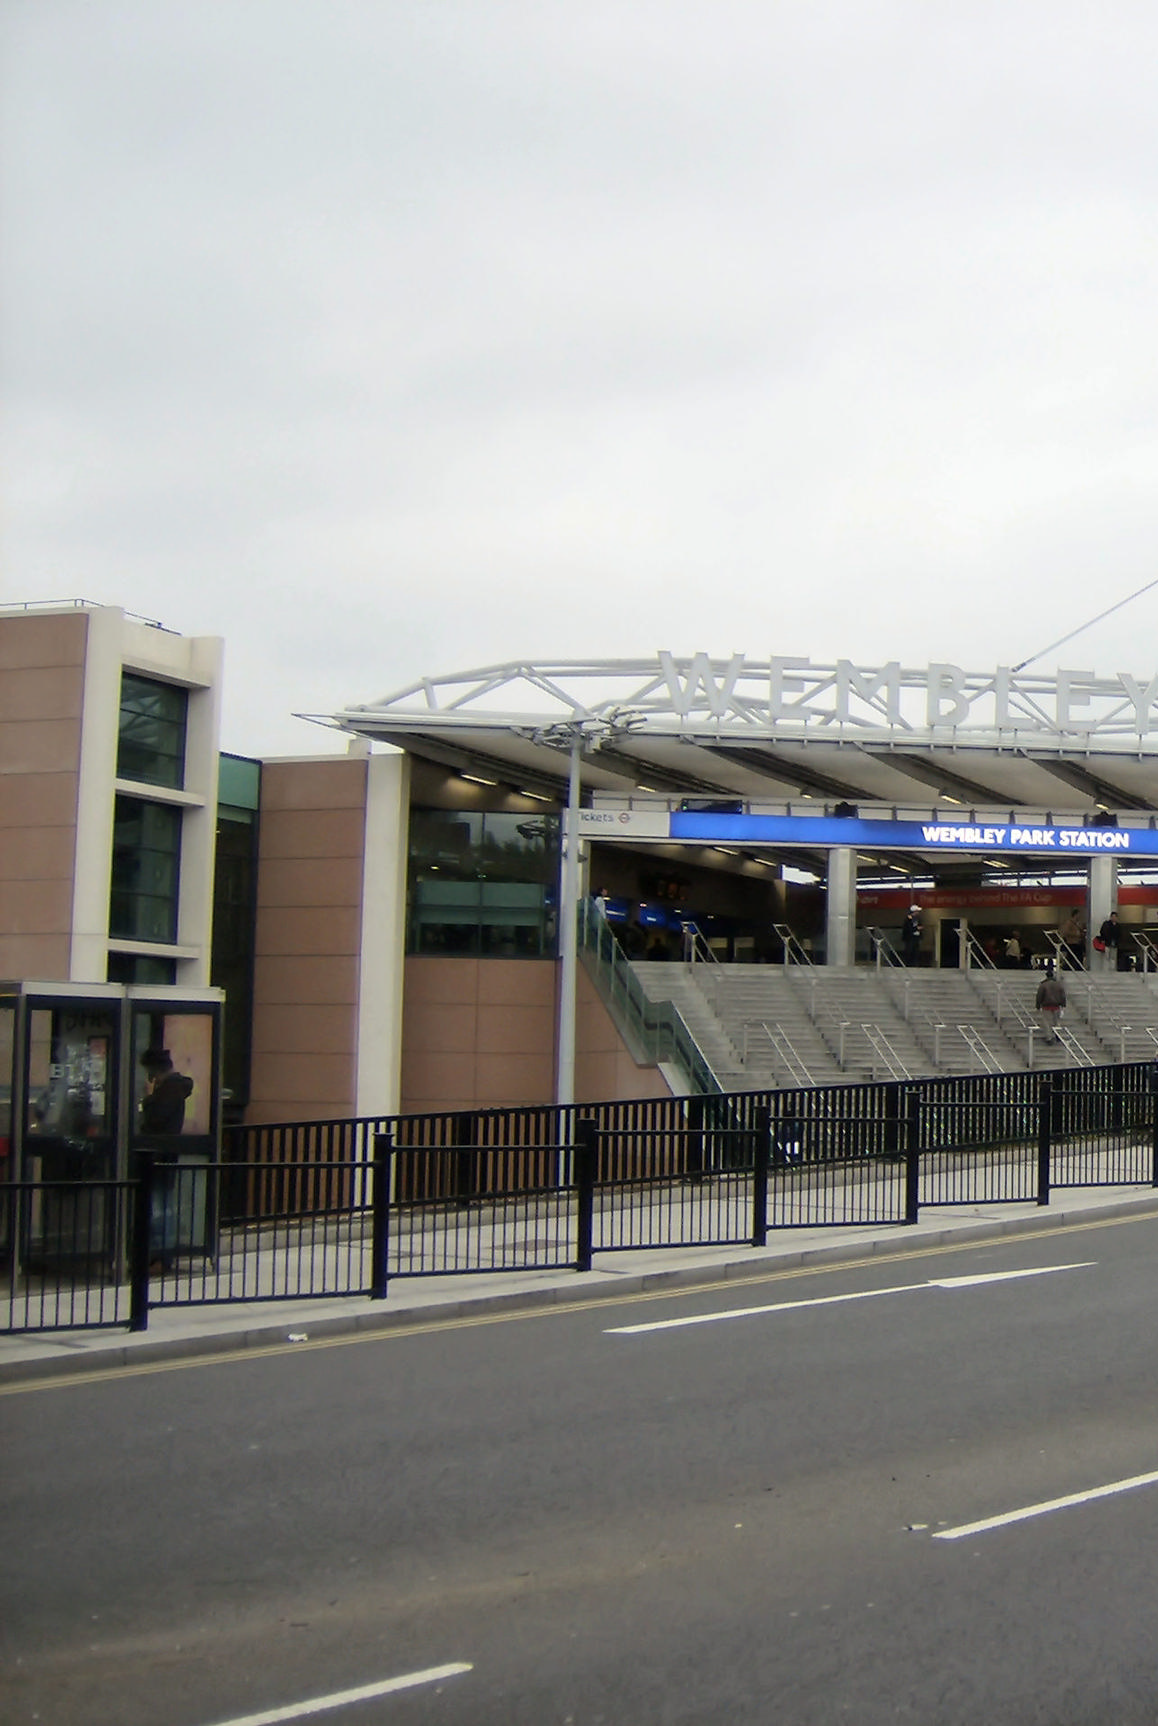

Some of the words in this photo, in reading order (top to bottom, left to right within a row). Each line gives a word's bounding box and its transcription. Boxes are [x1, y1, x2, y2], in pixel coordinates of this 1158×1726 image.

[579, 812, 615, 824] ickets
[921, 826, 1006, 844] WEMBLEY
[1010, 829, 1055, 846] PARK
[1059, 830, 1130, 848] STATION
